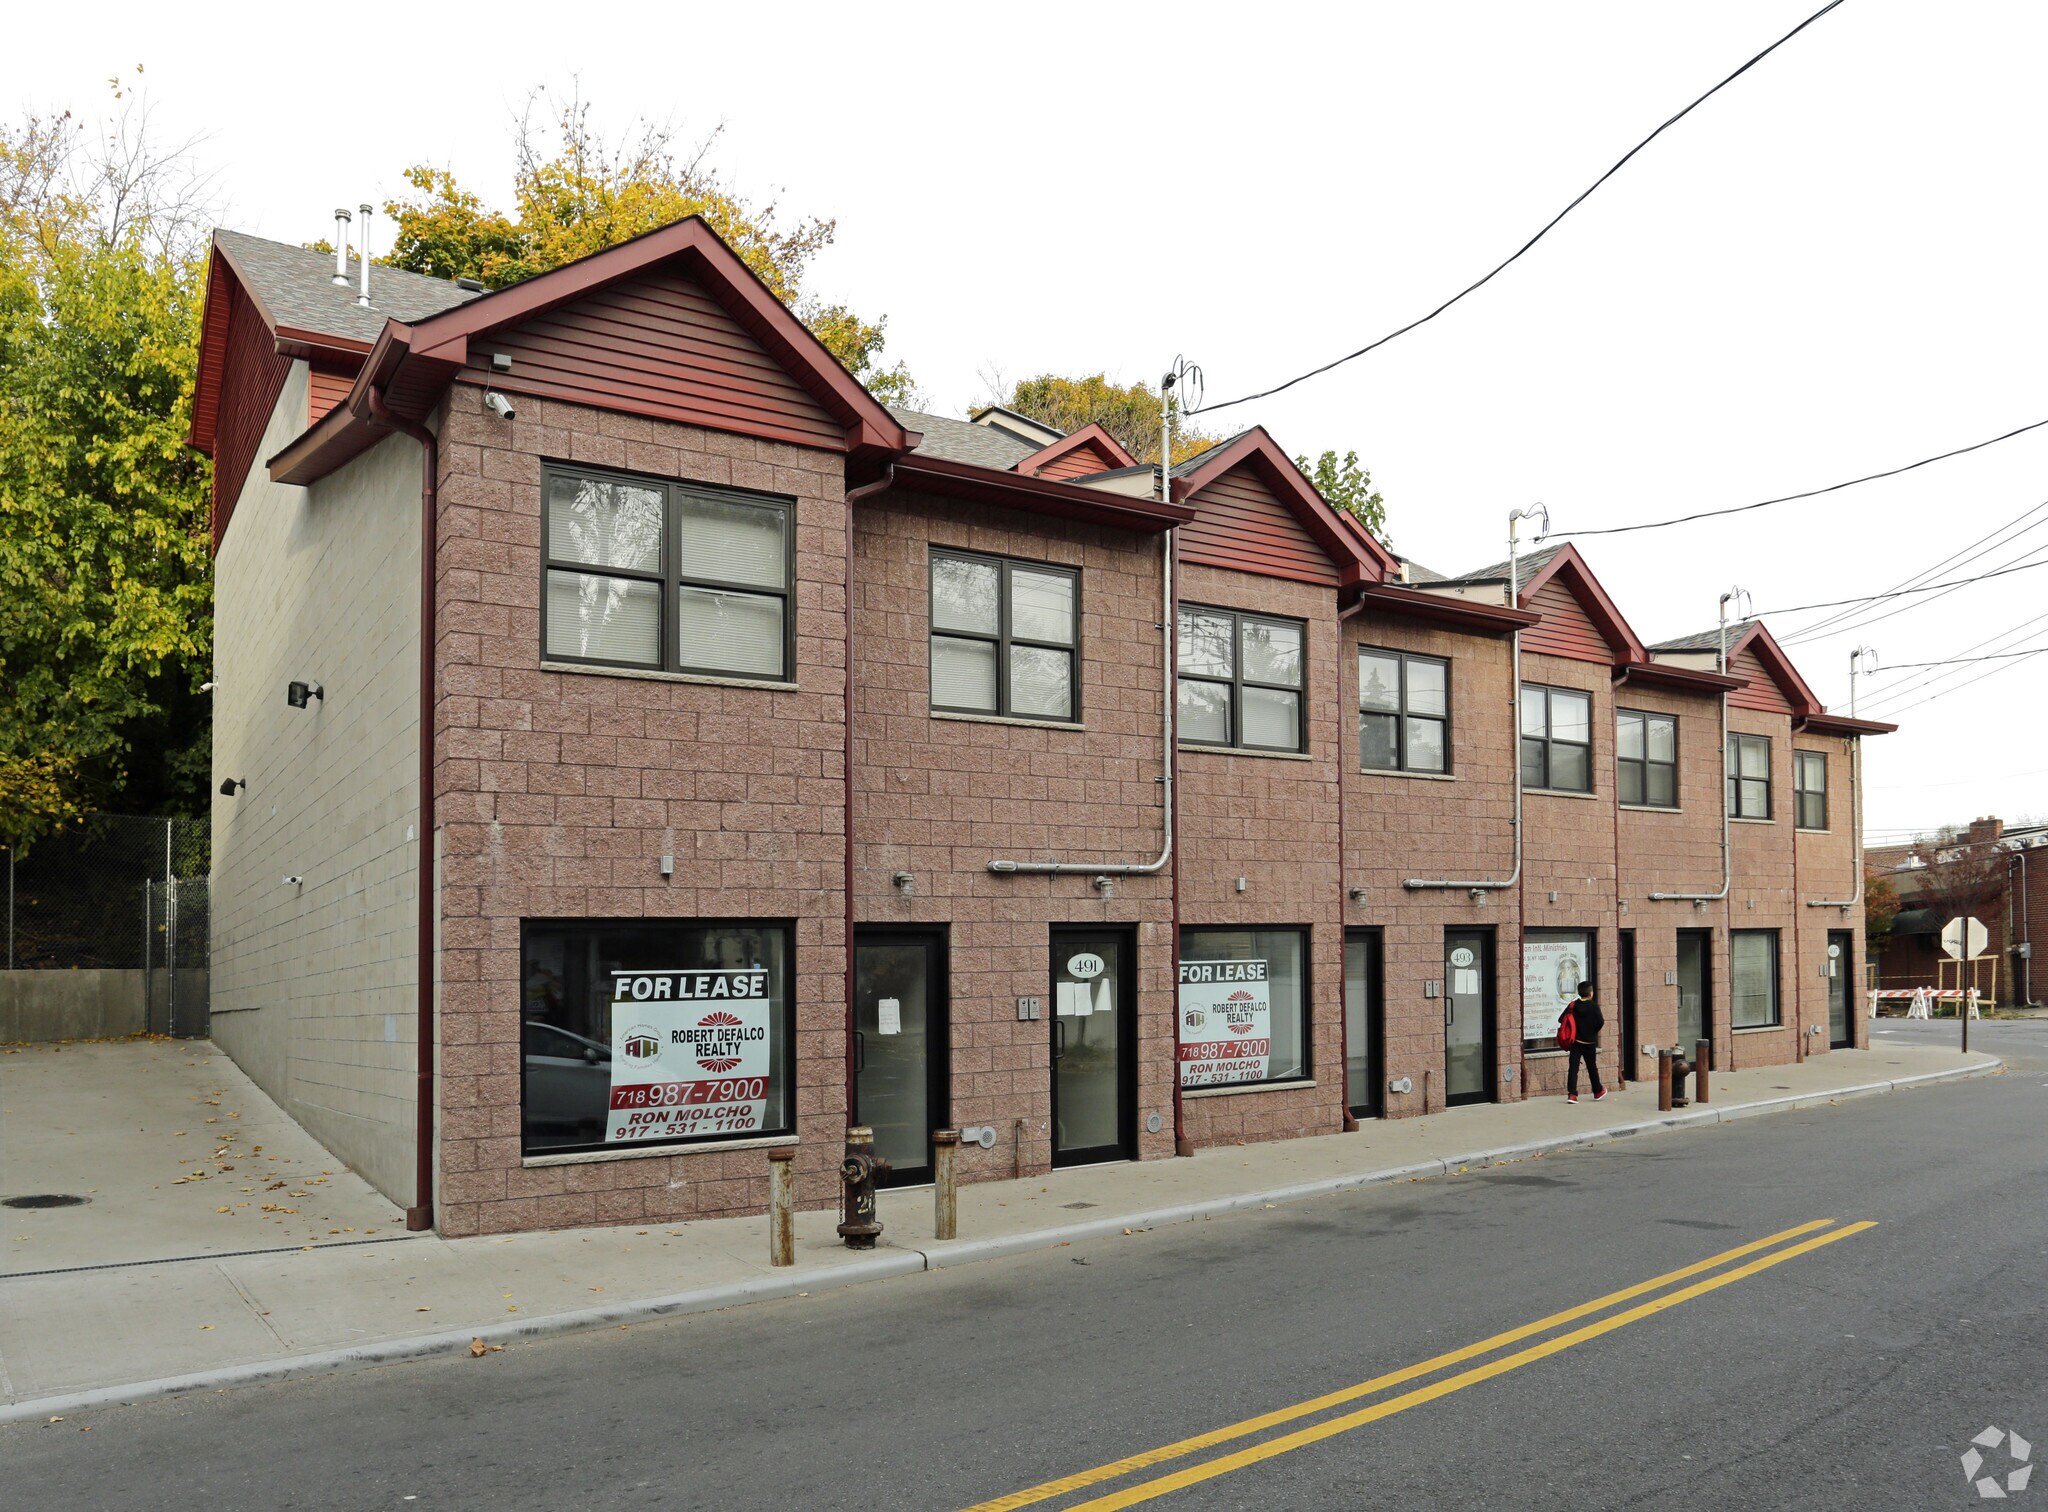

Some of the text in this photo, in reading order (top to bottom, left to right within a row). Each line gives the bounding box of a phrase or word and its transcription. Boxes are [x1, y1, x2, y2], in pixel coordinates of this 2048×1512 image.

[1454, 953, 1471, 962] 493
[1074, 960, 1097, 972] 491
[1179, 964, 1265, 982] FOR LEASE
[615, 975, 764, 1000] FOR LEASE
[1212, 1003, 1237, 1014] ROBERT
[1239, 1001, 1267, 1012] DEFALCO
[1226, 1012, 1254, 1023] REALTY
[671, 1026, 764, 1044] ROBERT DEFALCO
[695, 1042, 741, 1057] REALTY
[1182, 1040, 1267, 1059] 718 987-7900
[1189, 1060, 1261, 1074] RON MOLCHO
[1182, 1075, 1202, 1085] 917
[1211, 1072, 1229, 1083] 531
[1239, 1070, 1263, 1080] 1100
[617, 1078, 763, 1107] 718 987-7900
[628, 1104, 752, 1125] RON MOLCHO
[615, 1126, 649, 1139] 917
[665, 1122, 696, 1135] 531
[716, 1117, 755, 1131] 1100
